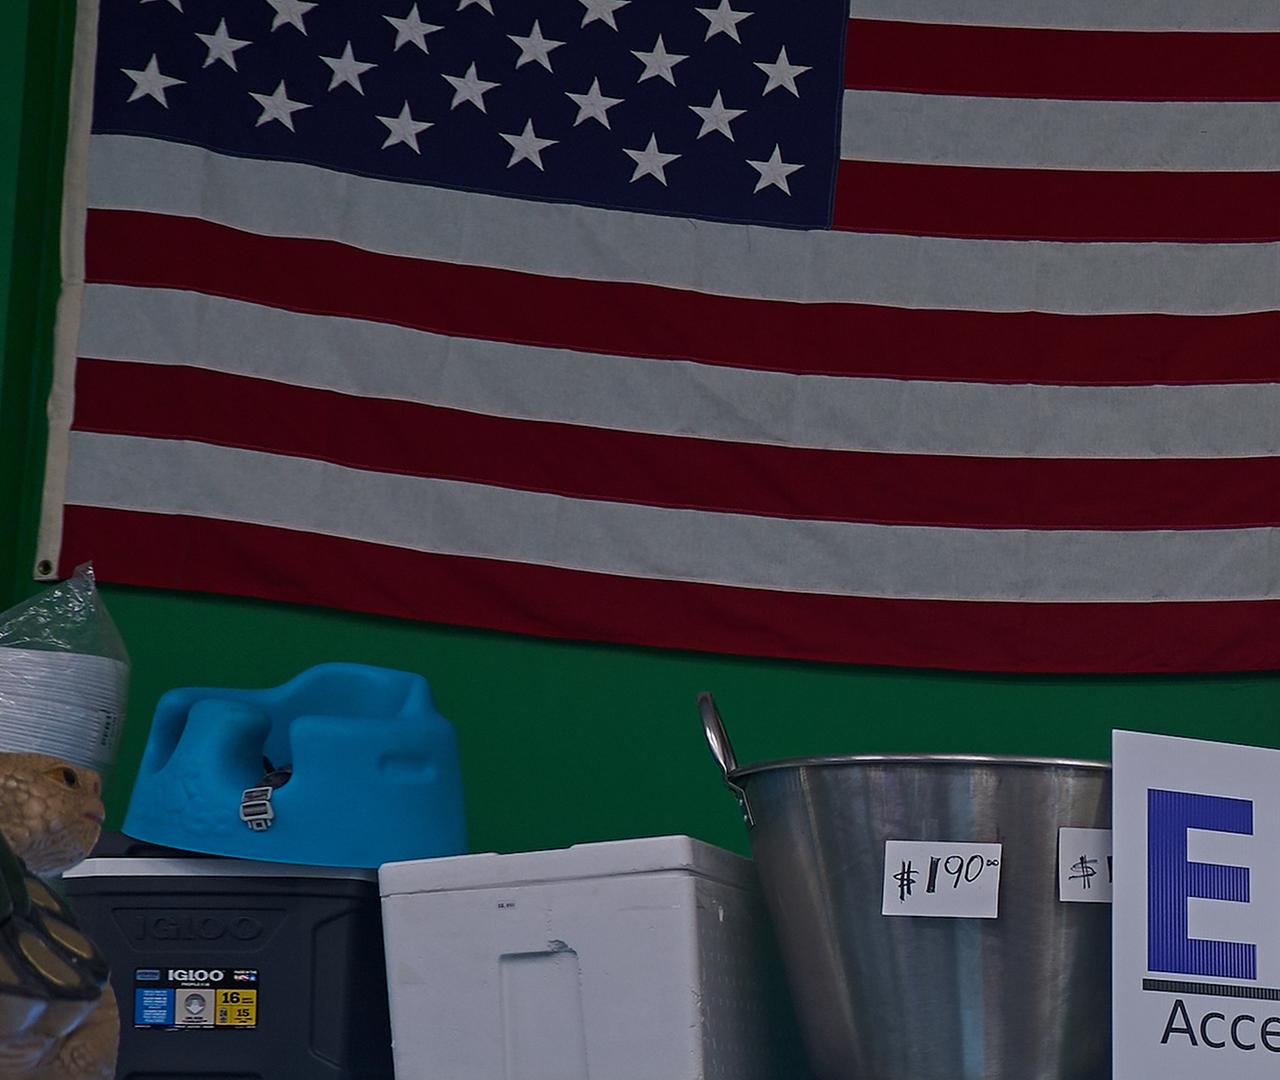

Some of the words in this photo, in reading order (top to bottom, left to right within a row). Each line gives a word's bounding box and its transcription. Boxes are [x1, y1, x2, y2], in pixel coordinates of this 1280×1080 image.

[168, 970, 224, 981] IGLOO
[222, 992, 240, 1004] 16
[236, 1008, 249, 1018] 15
